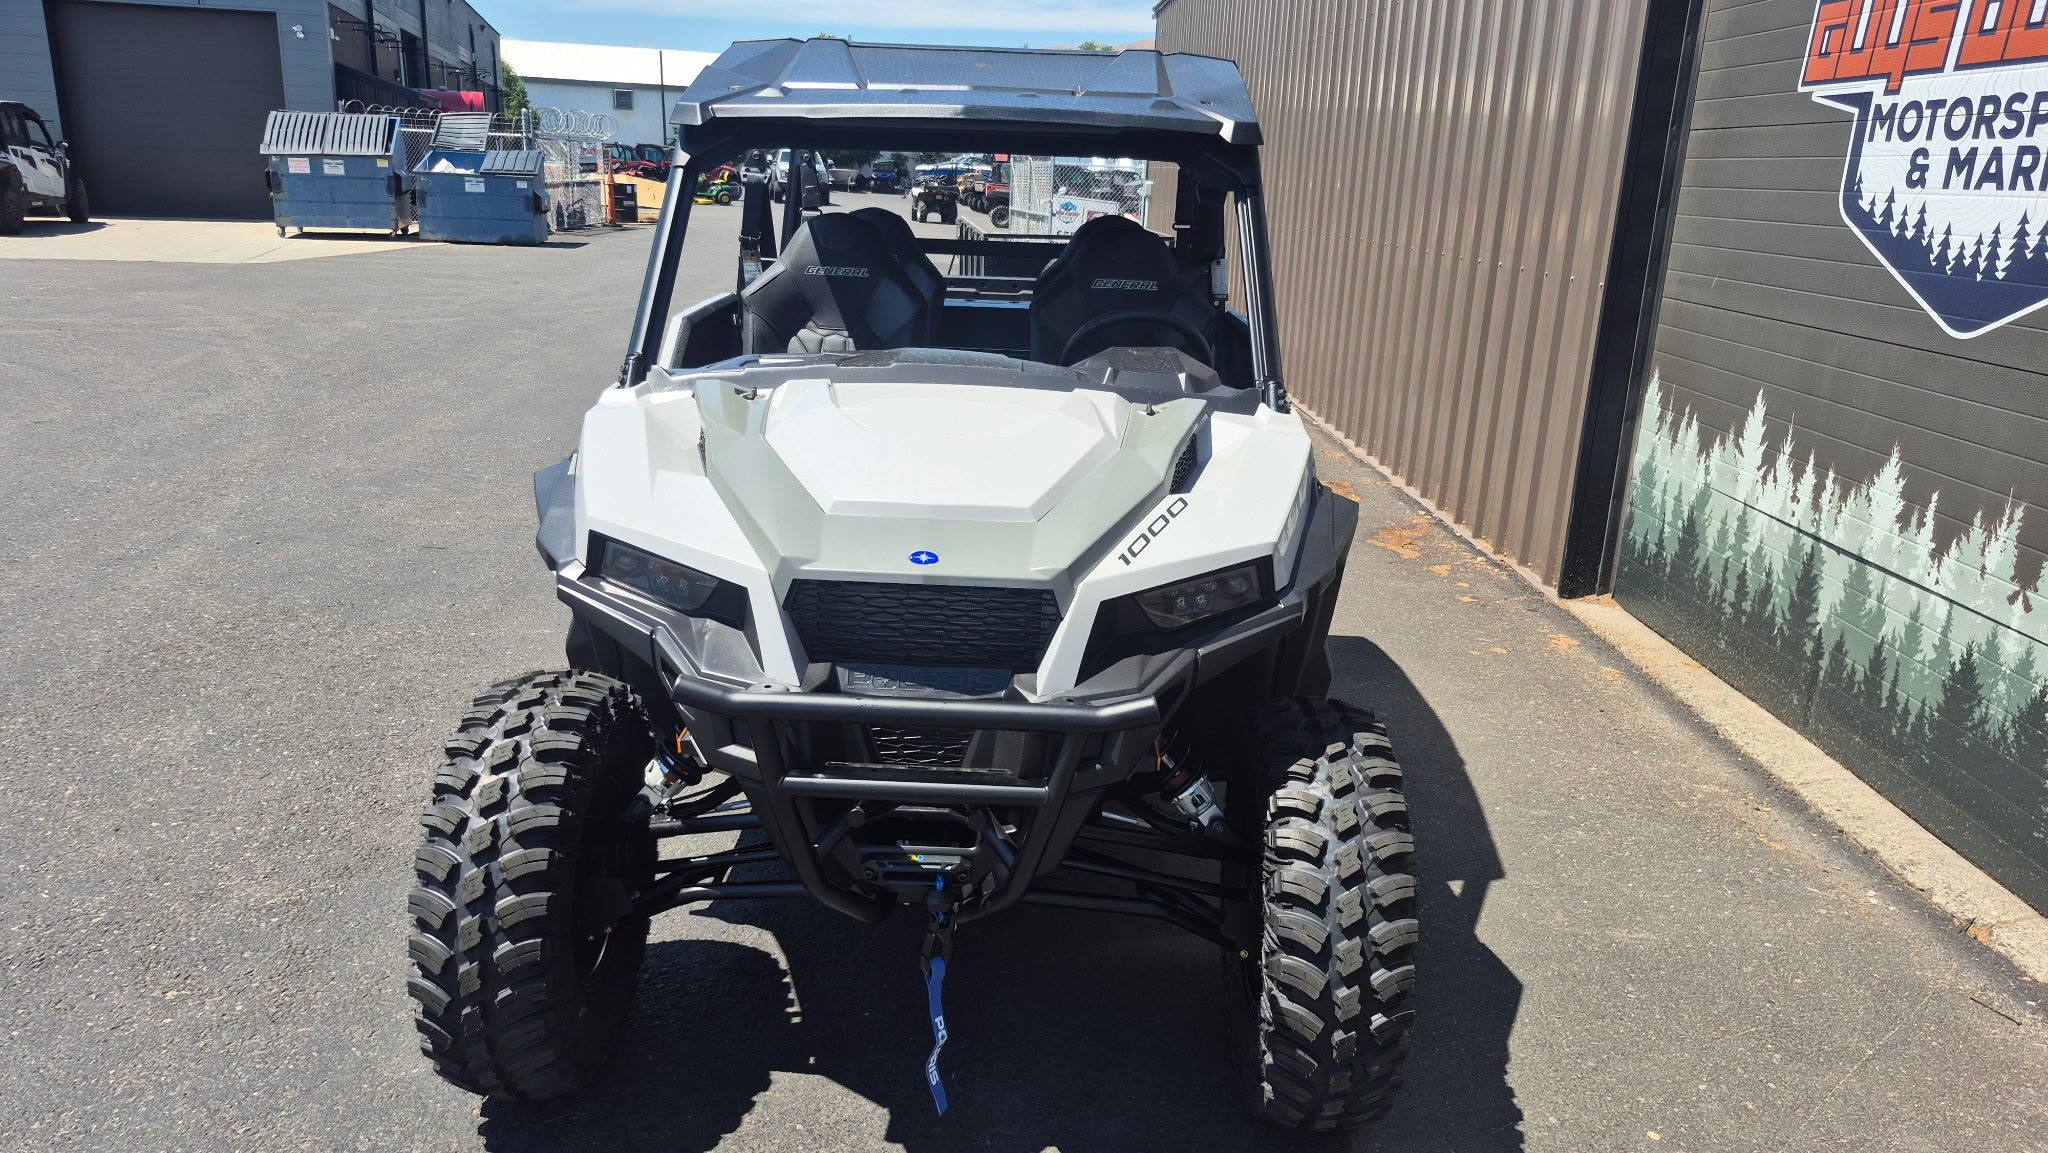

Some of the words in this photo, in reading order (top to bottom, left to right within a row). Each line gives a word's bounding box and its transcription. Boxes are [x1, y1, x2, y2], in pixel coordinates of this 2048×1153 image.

[1905, 147, 1930, 189] &
[804, 265, 870, 278] GENERAL
[1090, 278, 1160, 291] GENERAL
[1117, 497, 1189, 566] 1000
[847, 668, 999, 692] POLARIS
